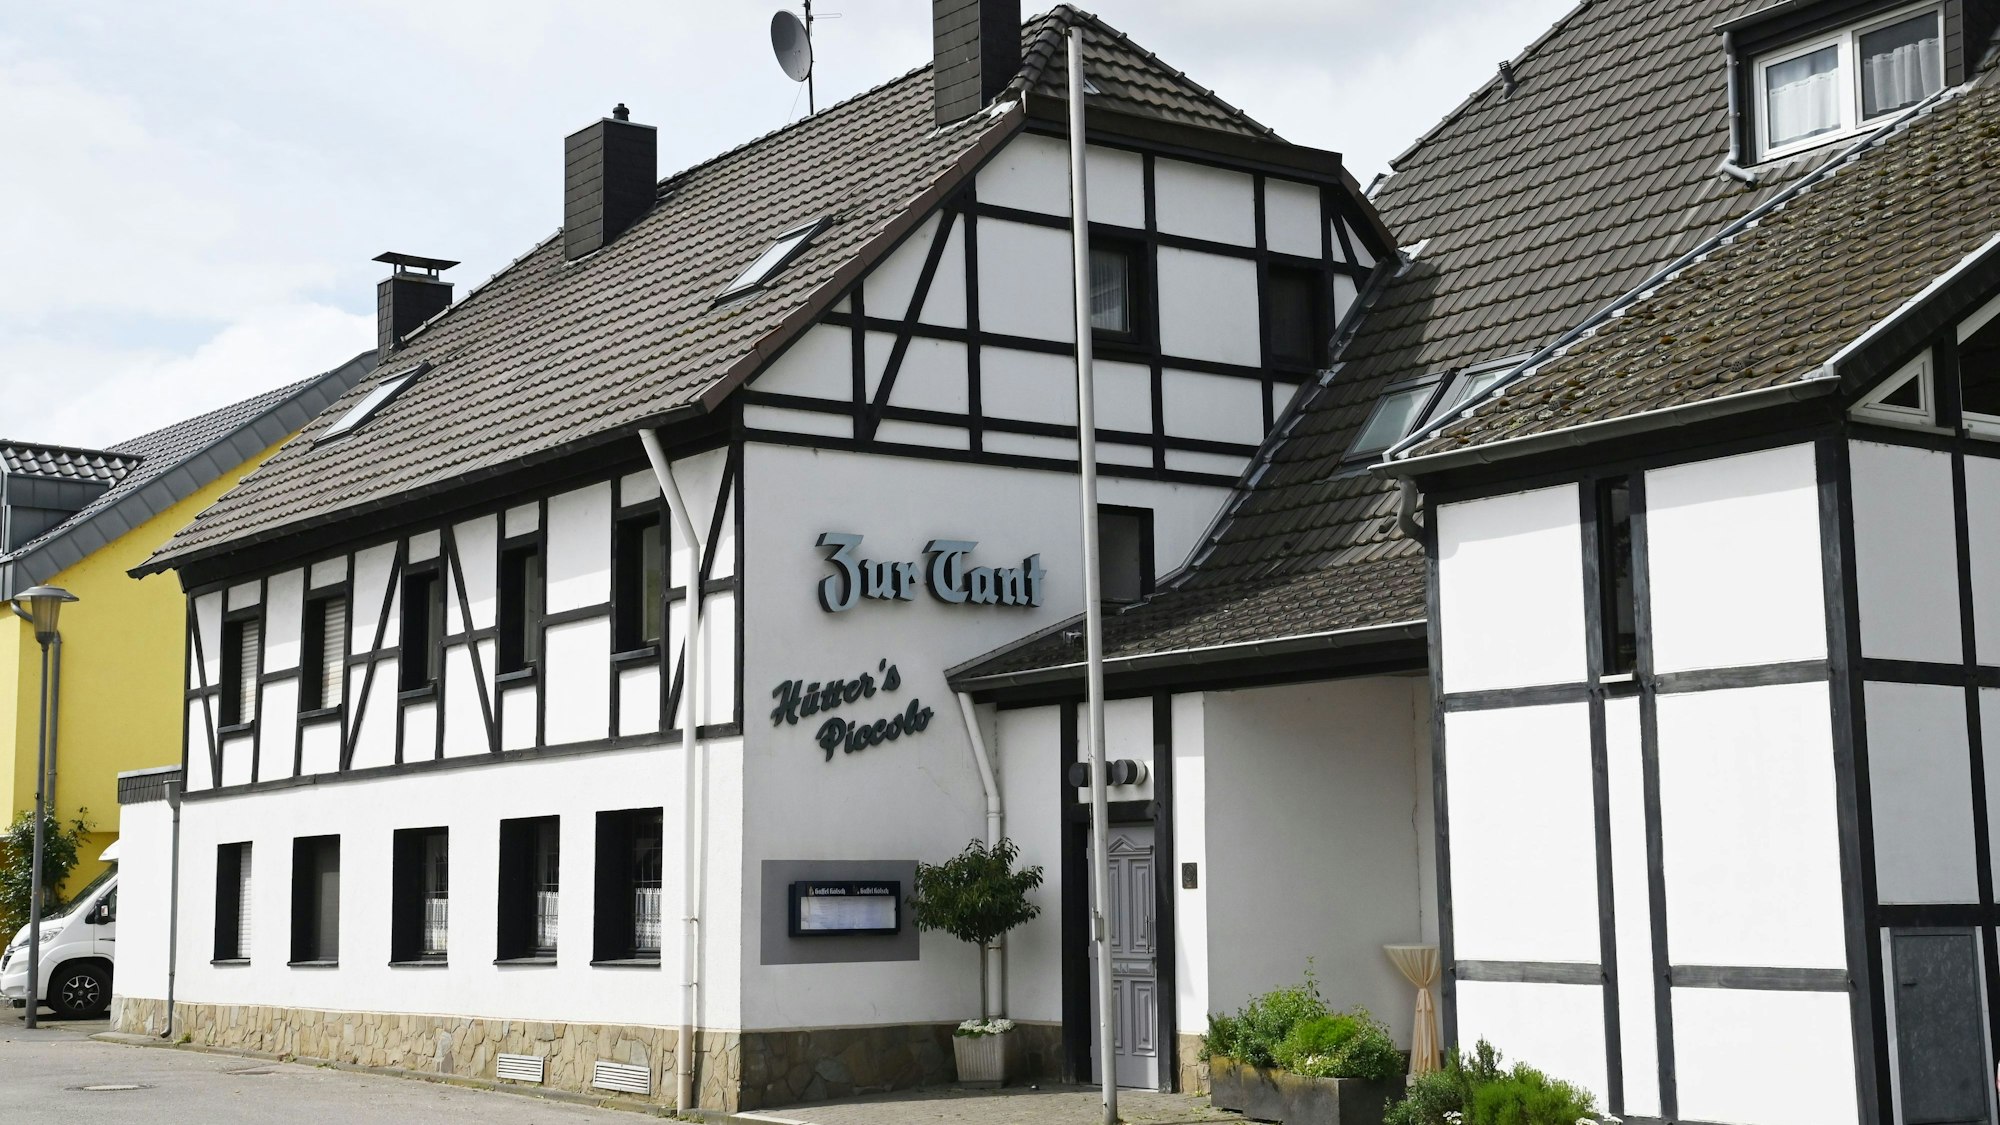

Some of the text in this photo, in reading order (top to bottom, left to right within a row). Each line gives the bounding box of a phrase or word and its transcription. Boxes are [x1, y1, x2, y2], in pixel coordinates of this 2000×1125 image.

[815, 532, 1047, 613] Zur Tant
[770, 658, 902, 727] Hütter's
[815, 698, 934, 762] Piccolo
